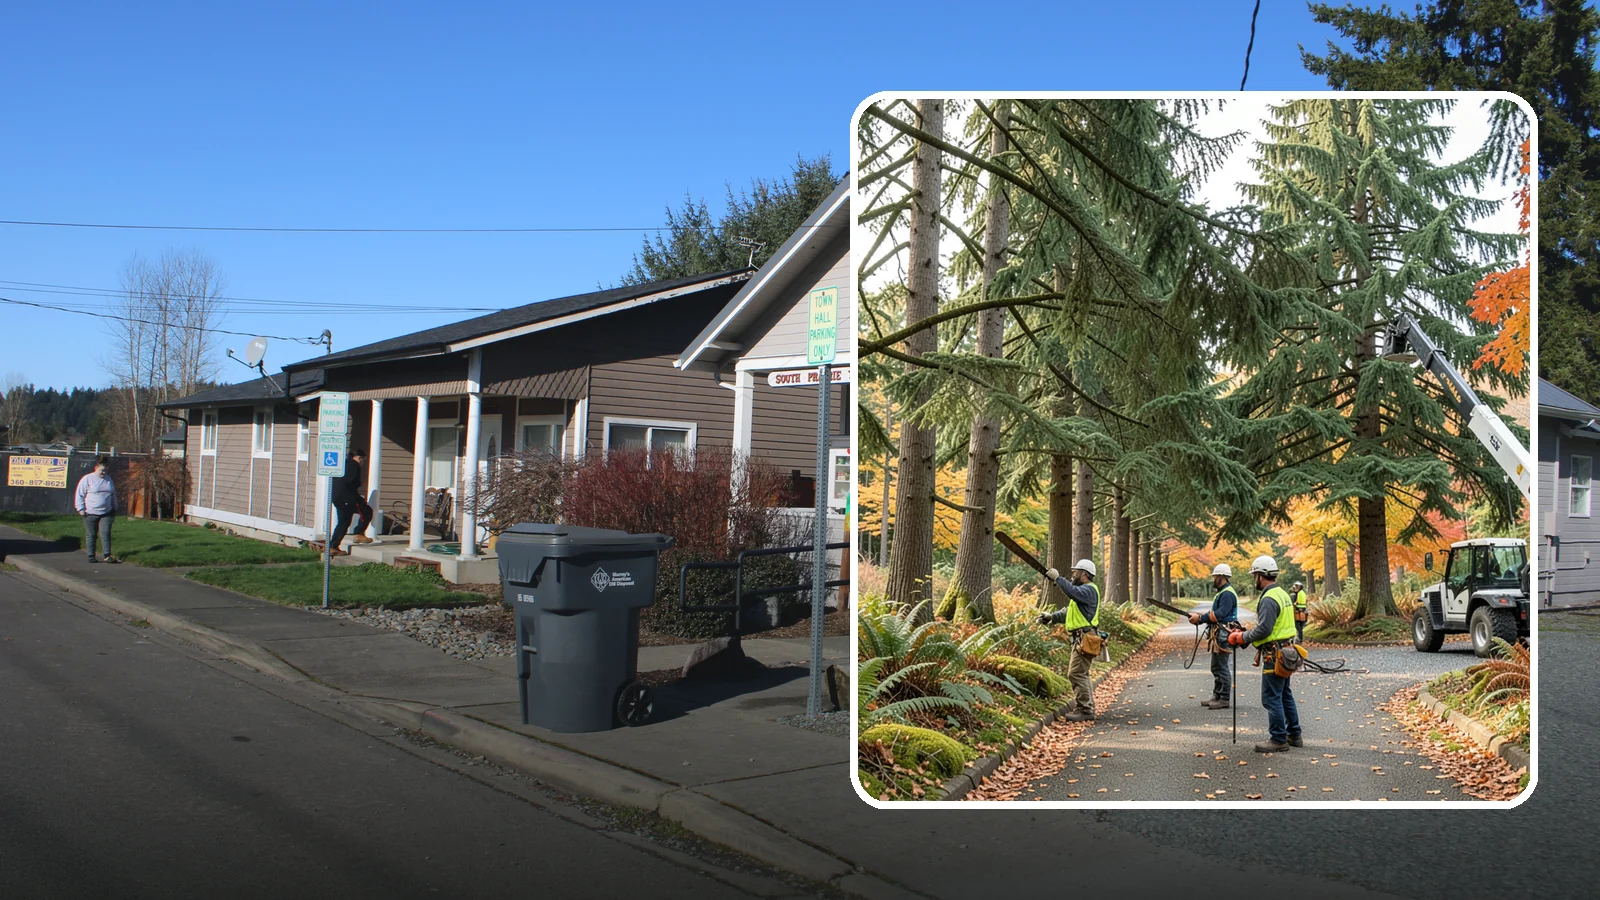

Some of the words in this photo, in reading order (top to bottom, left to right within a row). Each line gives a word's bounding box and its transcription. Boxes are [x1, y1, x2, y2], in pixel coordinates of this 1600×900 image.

[815, 295, 833, 308] TOWN
[814, 312, 831, 324] HALL
[810, 327, 835, 340] PARKING
[813, 344, 830, 357] ONLY
[775, 374, 801, 384] SOUTH
